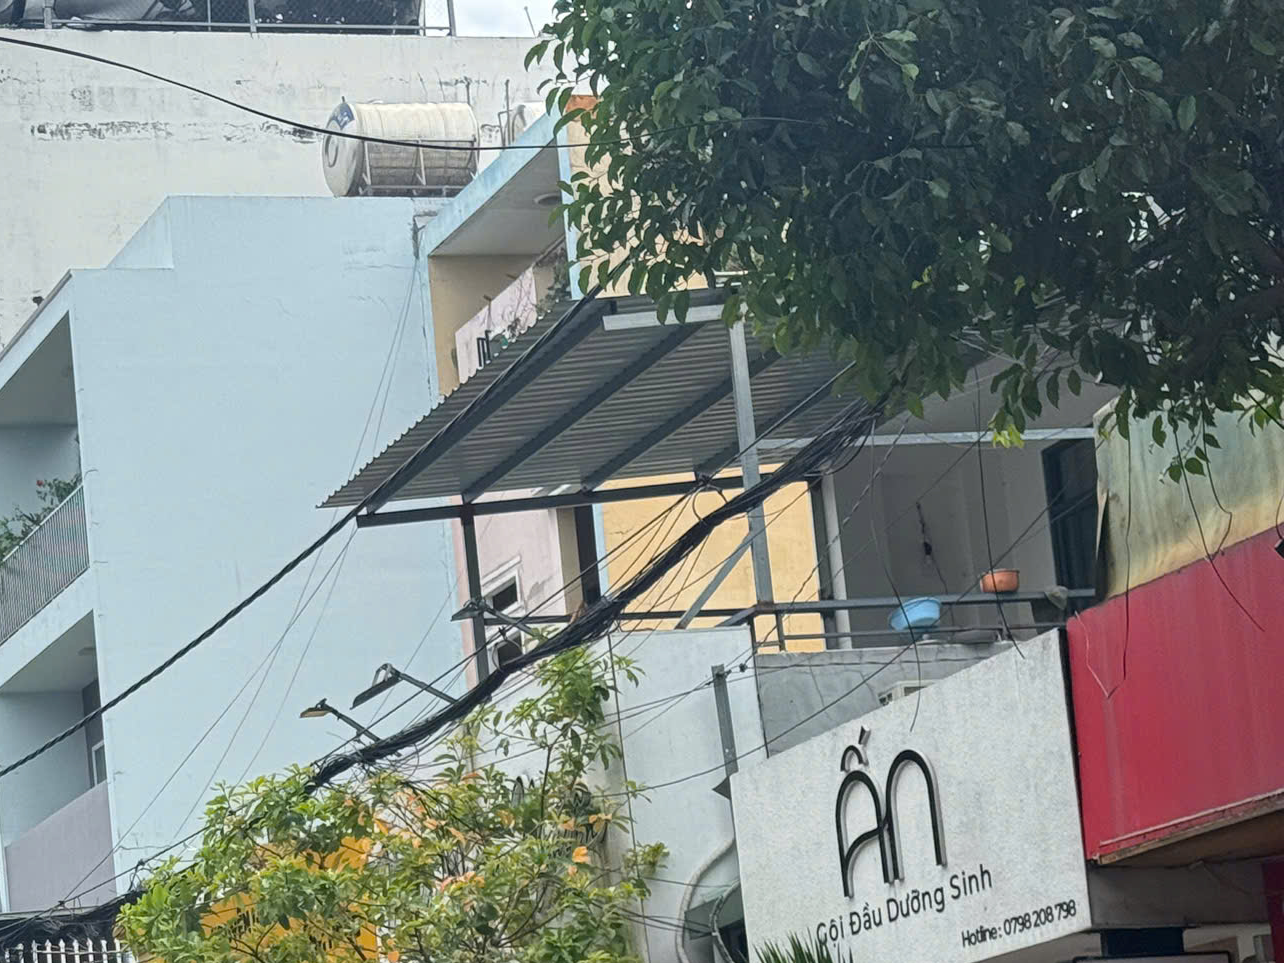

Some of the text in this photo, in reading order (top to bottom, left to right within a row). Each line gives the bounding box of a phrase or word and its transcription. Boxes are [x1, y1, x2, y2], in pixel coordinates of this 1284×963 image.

[816, 864, 993, 947] Gội Đầu Dưỡng Sinh
[1004, 914, 1032, 936] 0798
[1033, 906, 1054, 928] 208
[1055, 899, 1077, 921] 798
